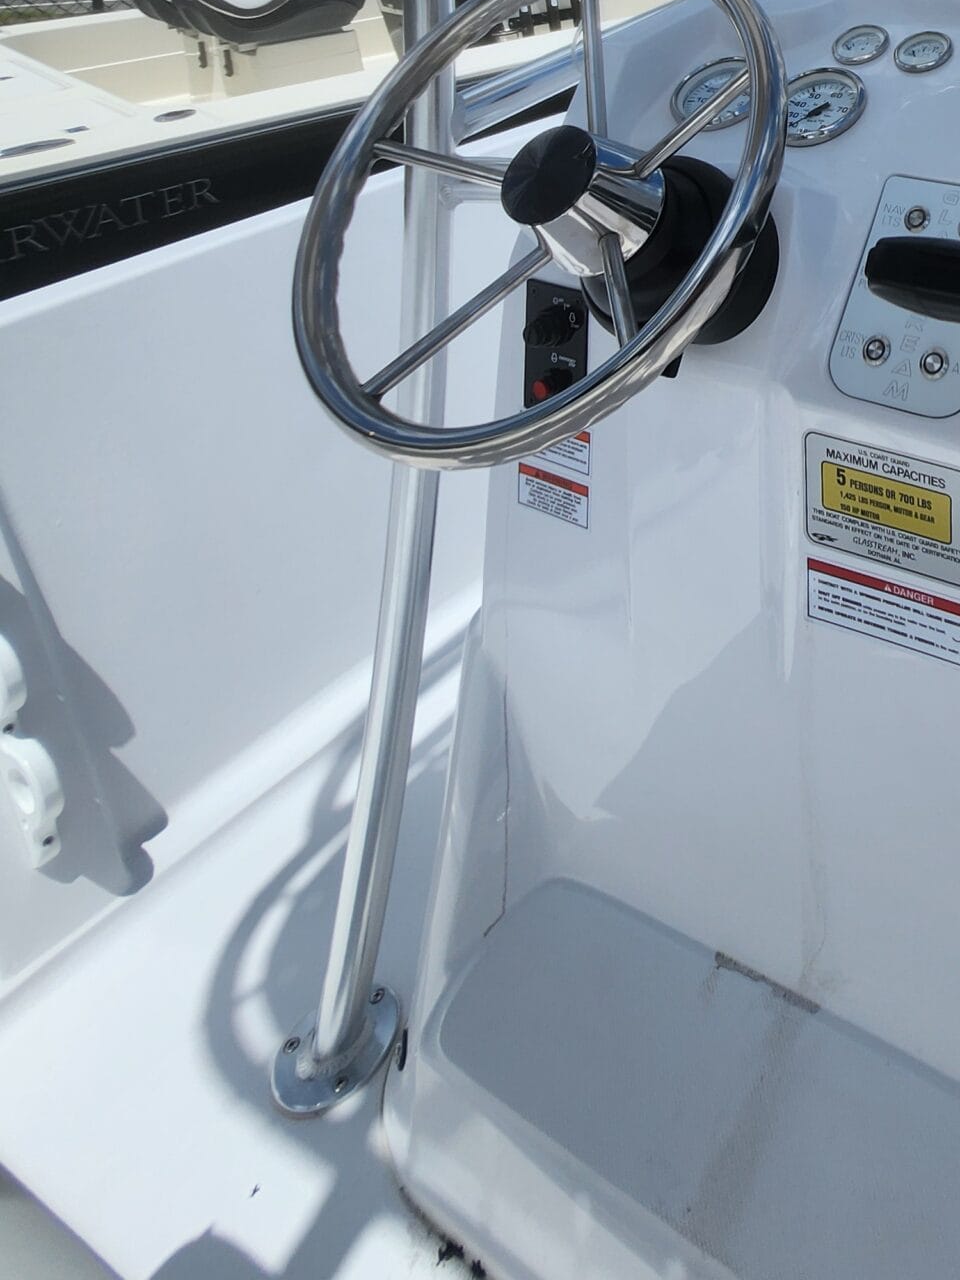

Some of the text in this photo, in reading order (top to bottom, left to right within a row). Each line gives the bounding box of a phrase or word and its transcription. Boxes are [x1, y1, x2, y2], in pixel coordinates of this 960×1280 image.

[826, 448, 946, 489] MAXIMUM CAPACITIES
[836, 468, 932, 511] 5 PERSONS OR 700 LBS
[893, 585, 934, 606] DANGER
